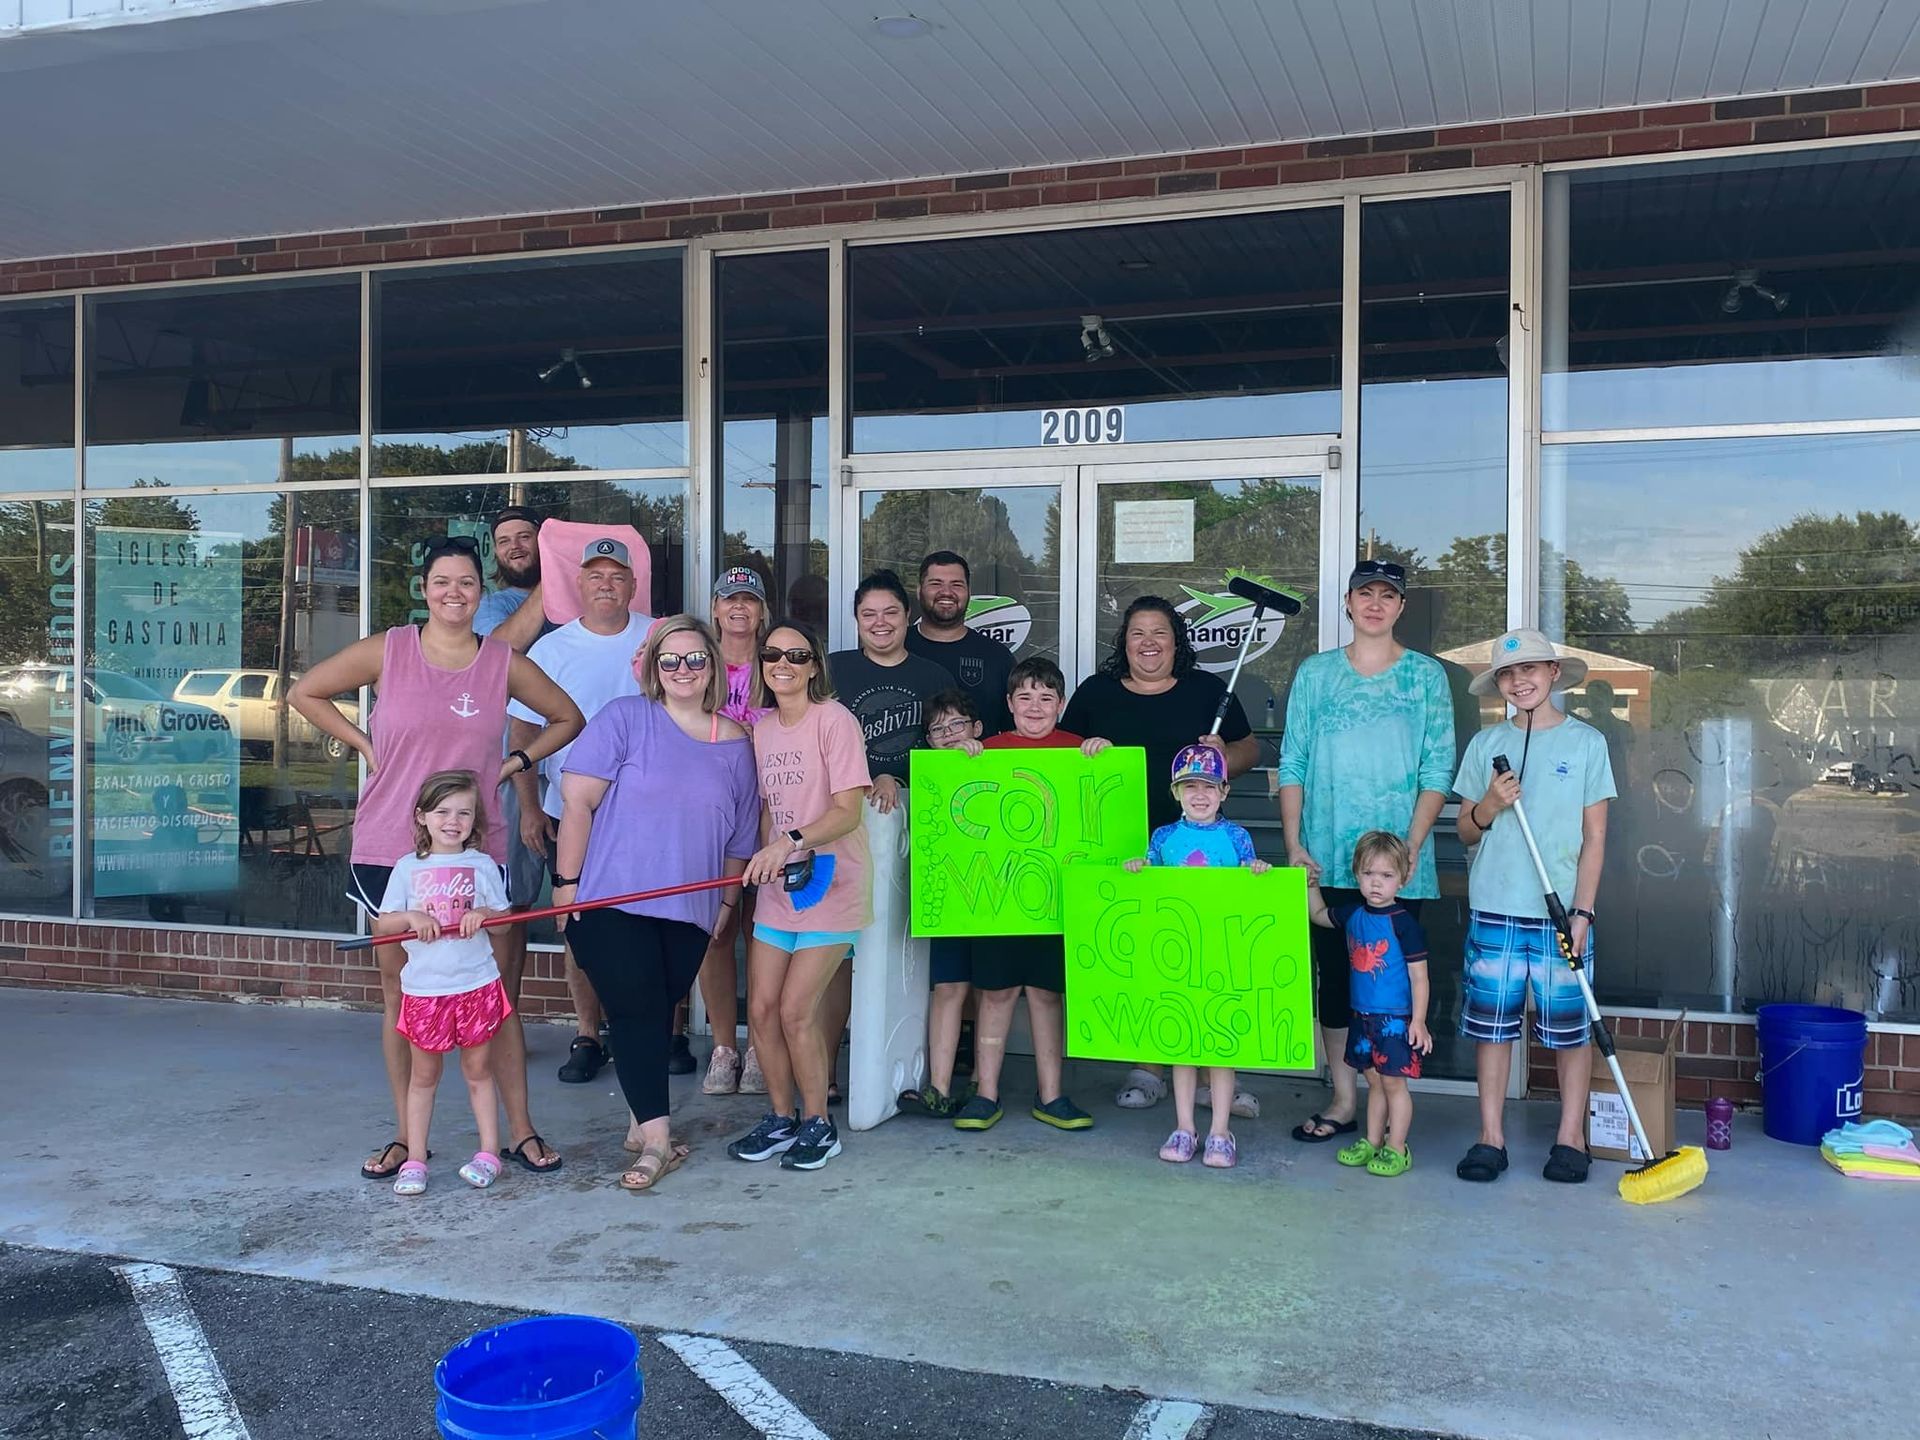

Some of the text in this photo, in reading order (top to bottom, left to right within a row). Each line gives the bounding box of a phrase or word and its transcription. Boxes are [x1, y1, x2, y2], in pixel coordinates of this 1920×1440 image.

[1043, 407, 1122, 445] 2009
[153, 581, 178, 606] DE
[108, 619, 226, 645] GASTONIA
[161, 708, 231, 732] Groves
[860, 700, 922, 741] ashvill
[763, 750, 803, 769] ESUS
[95, 773, 231, 790] EXALTANDO A CRISTO
[765, 770, 805, 787] OVES
[162, 795, 170, 808] Y
[950, 767, 1124, 848] car
[414, 872, 475, 901] Barbie
[942, 848, 1119, 921] wa
